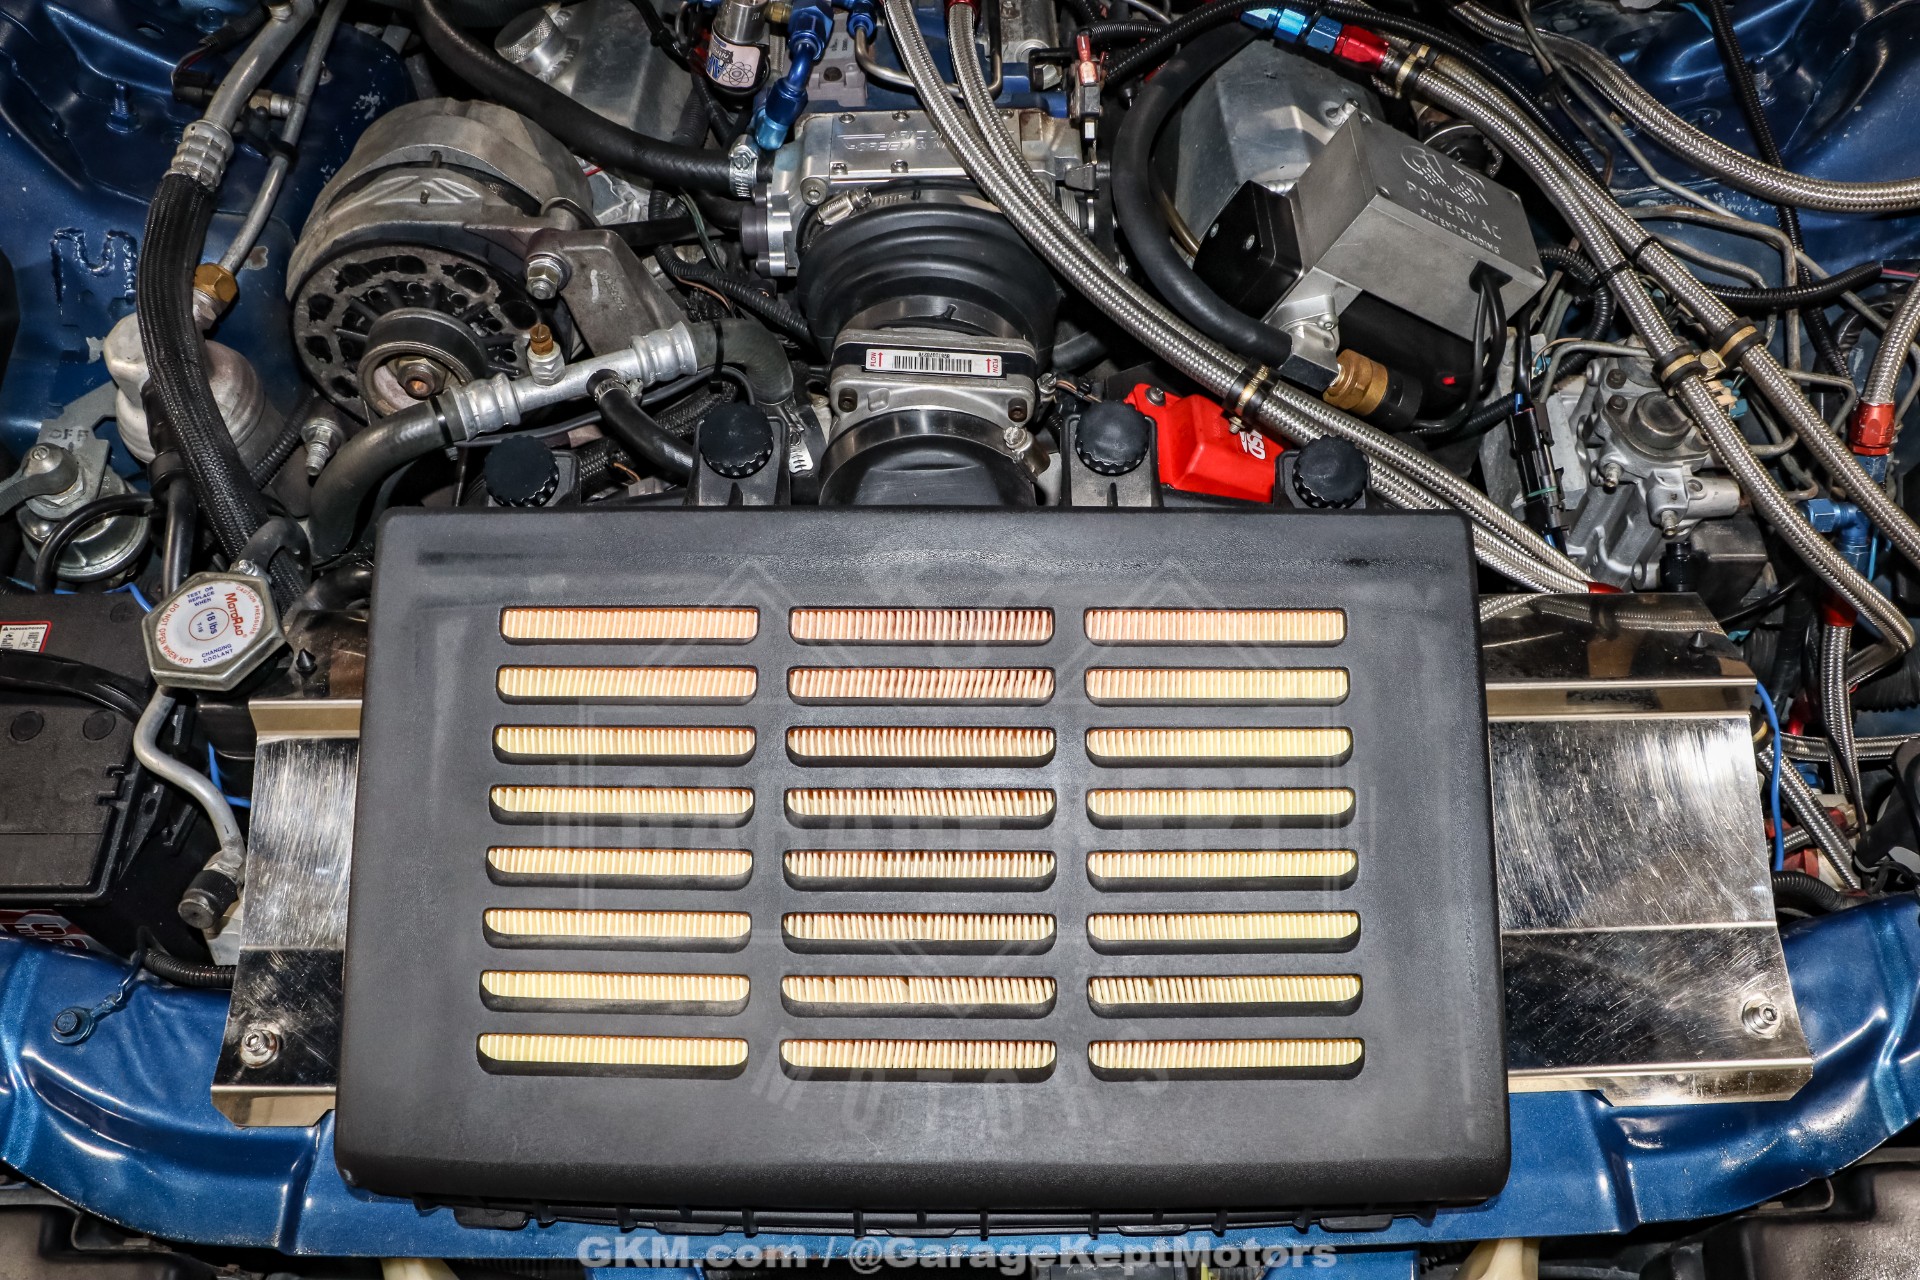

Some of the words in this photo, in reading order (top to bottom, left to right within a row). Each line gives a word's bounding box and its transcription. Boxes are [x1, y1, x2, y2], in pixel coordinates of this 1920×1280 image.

[1406, 180, 1501, 240] POWERVAC
[1420, 208, 1458, 232] PATENT
[1460, 228, 1500, 254] PENDING
[49, 428, 89, 442] OFF
[186, 591, 202, 599] TEST
[188, 591, 215, 603] REPLACE
[170, 603, 180, 613] DO
[194, 598, 212, 607] WHEN
[206, 612, 216, 622] 18
[235, 585, 257, 603] CAUTION
[250, 605, 261, 635] PRESSURE
[161, 612, 172, 627] NOT
[208, 621, 218, 635] lbs
[158, 629, 167, 645] OPEN
[163, 645, 179, 660] WHEN
[201, 643, 232, 658] CHANGING
[202, 648, 234, 664] COOLANT
[178, 657, 194, 665] HOT
